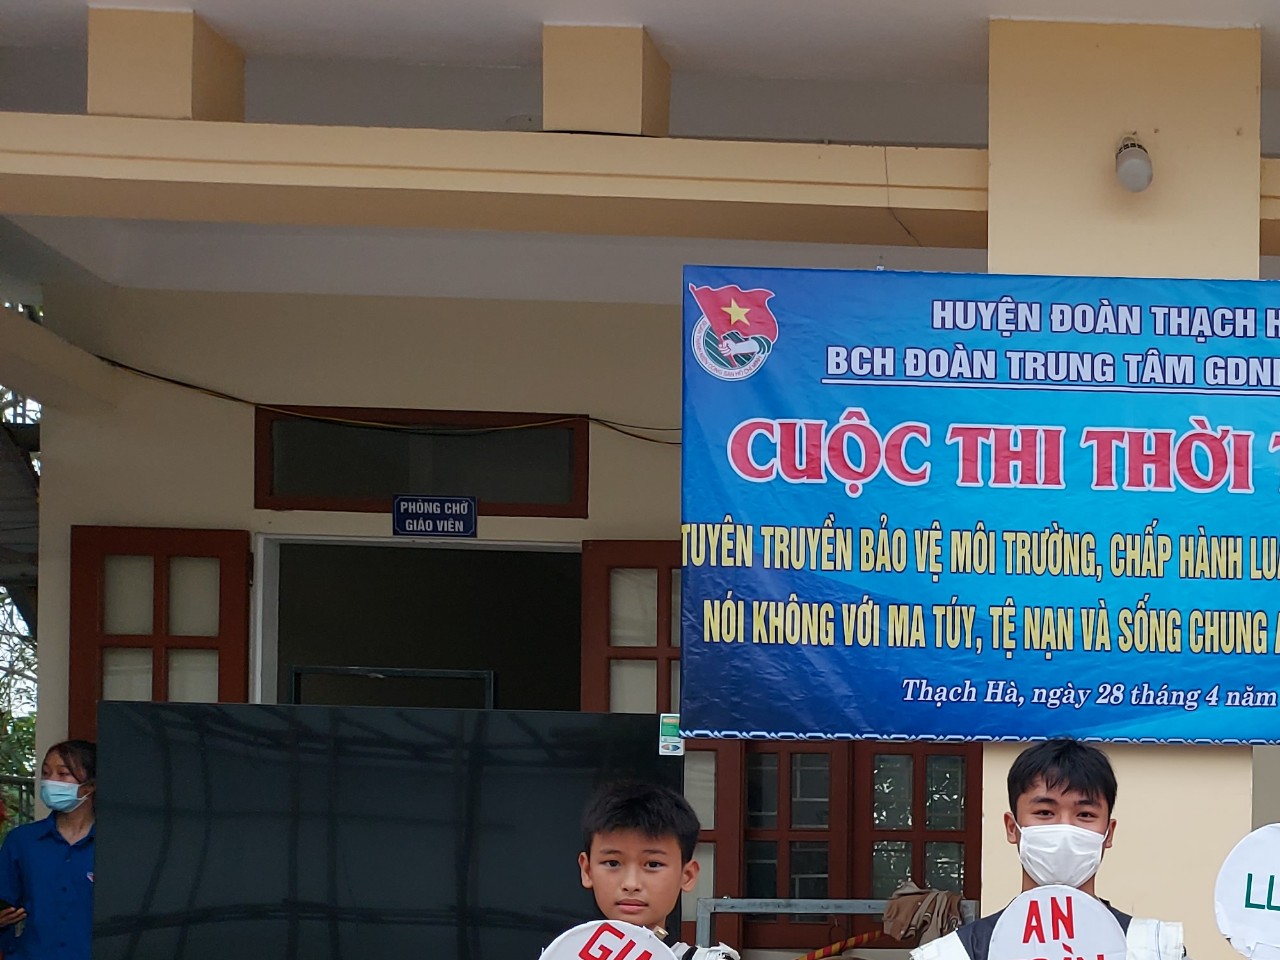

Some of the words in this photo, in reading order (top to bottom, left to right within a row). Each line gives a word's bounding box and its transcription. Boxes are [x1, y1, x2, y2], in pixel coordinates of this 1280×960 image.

[932, 296, 1040, 337] HUYỆN
[1051, 299, 1140, 335] ĐOÀN
[1151, 306, 1256, 343] THẠCH
[826, 346, 894, 376] BCH
[905, 344, 996, 380] ĐOÀN
[1006, 352, 1115, 382] TRUNG
[1125, 349, 1195, 384] TÂM
[727, 407, 931, 498] CUỘC
[946, 423, 1066, 489] THI
[1080, 416, 1254, 493] THỜI
[405, 517, 433, 531] GIÁO
[436, 518, 464, 532] VIÊN
[681, 514, 753, 567] TUYÊN
[761, 513, 852, 571] TRUYỀN
[860, 514, 905, 574] BẢO
[914, 521, 943, 582] VỆ
[950, 521, 996, 575] MÔI
[1002, 522, 1103, 581] TRƯỜNG,
[1110, 519, 1172, 577] CHẤP
[1179, 526, 1243, 580] HÀNH
[703, 591, 744, 644] NÓI
[752, 593, 835, 646] KHÔNG
[841, 595, 880, 647] VỚI
[887, 605, 925, 647] MA
[933, 596, 982, 653] TÚY,
[989, 598, 1016, 659] TỆ
[1024, 607, 1073, 660] NẠN
[1080, 600, 1111, 652] VÀ
[1117, 593, 1181, 653] SỐNG
[1189, 610, 1267, 653] CHUNG
[902, 680, 977, 709] Thạch
[984, 681, 1024, 707] Hà,
[1032, 686, 1091, 708] ngày
[1096, 683, 1124, 705] 28
[1130, 684, 1198, 710] tháng
[1205, 685, 1220, 707] 4
[1226, 686, 1276, 708] năm
[1022, 896, 1074, 943] AN
